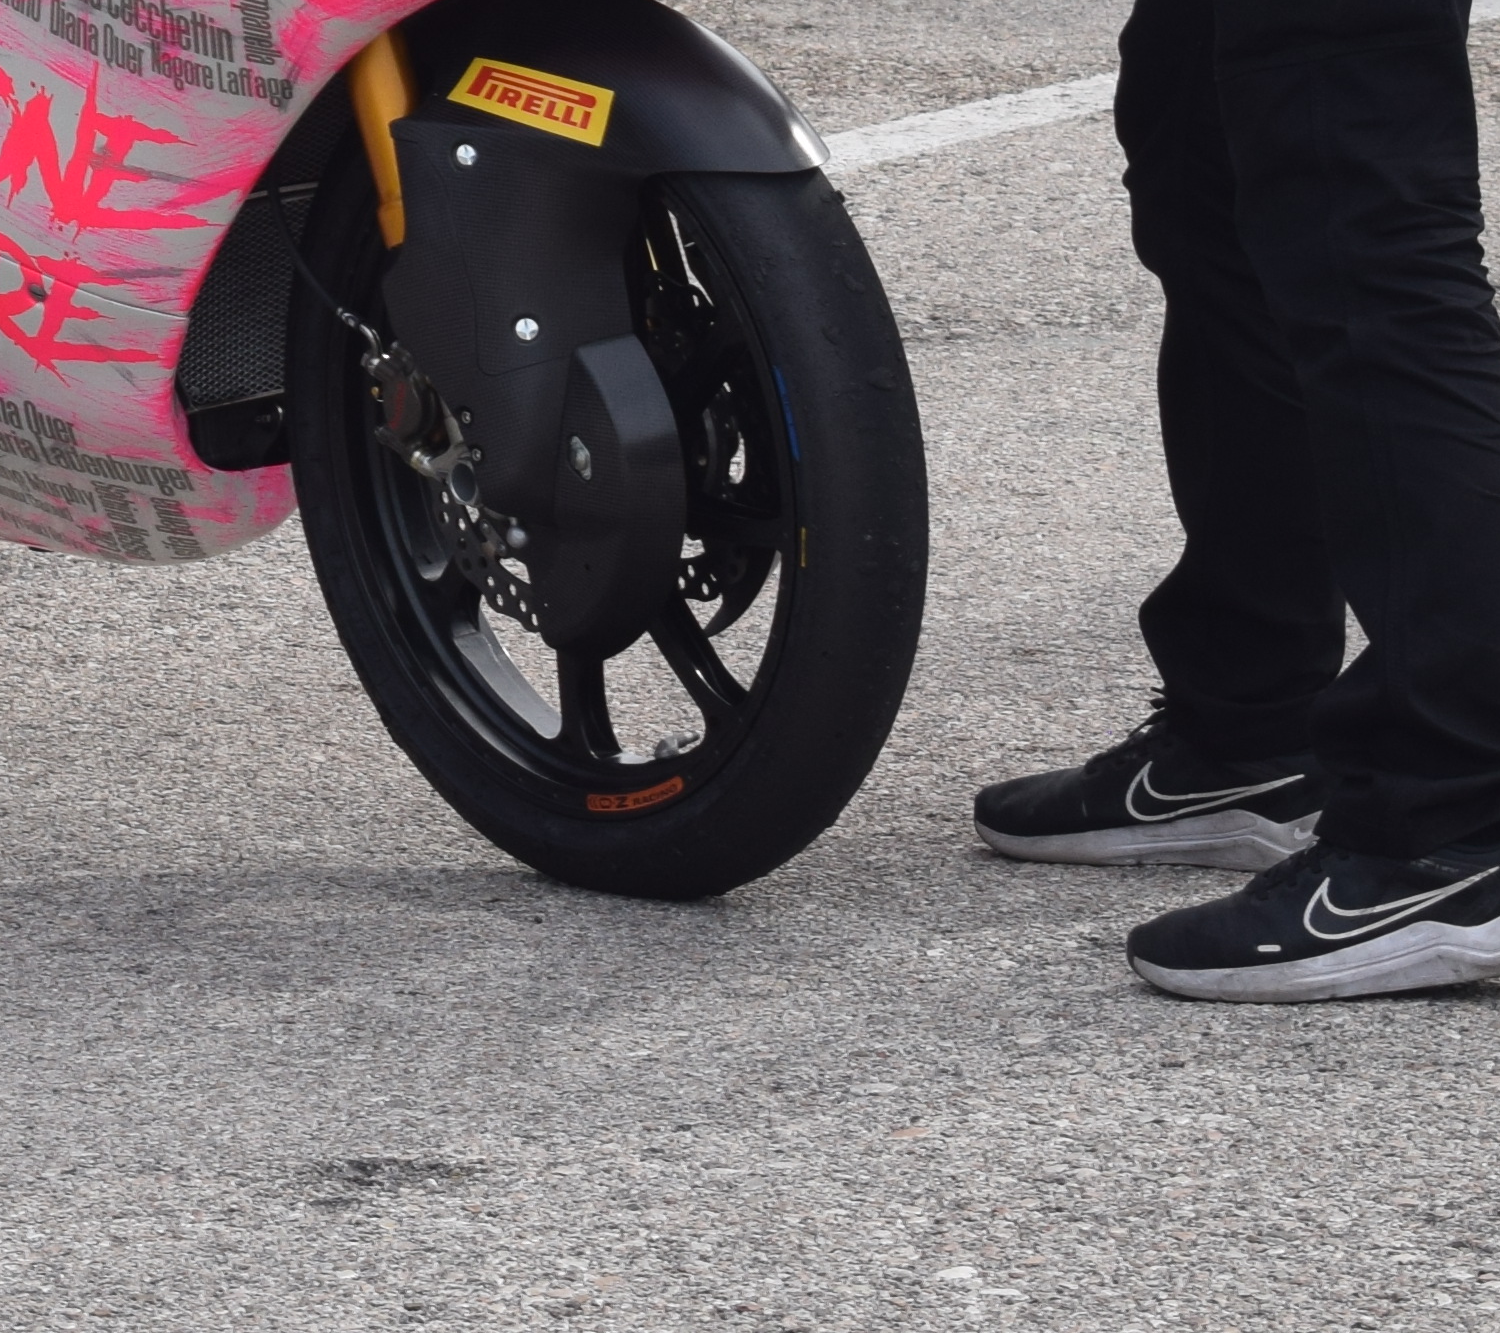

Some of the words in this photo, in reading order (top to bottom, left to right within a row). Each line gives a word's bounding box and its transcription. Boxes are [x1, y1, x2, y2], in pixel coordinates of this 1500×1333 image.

[103, 23, 146, 78] Quer
[149, 40, 214, 92] Nagore
[217, 61, 294, 110] Laffage
[466, 66, 597, 130] PIRELLI
[24, 400, 78, 446] Quer
